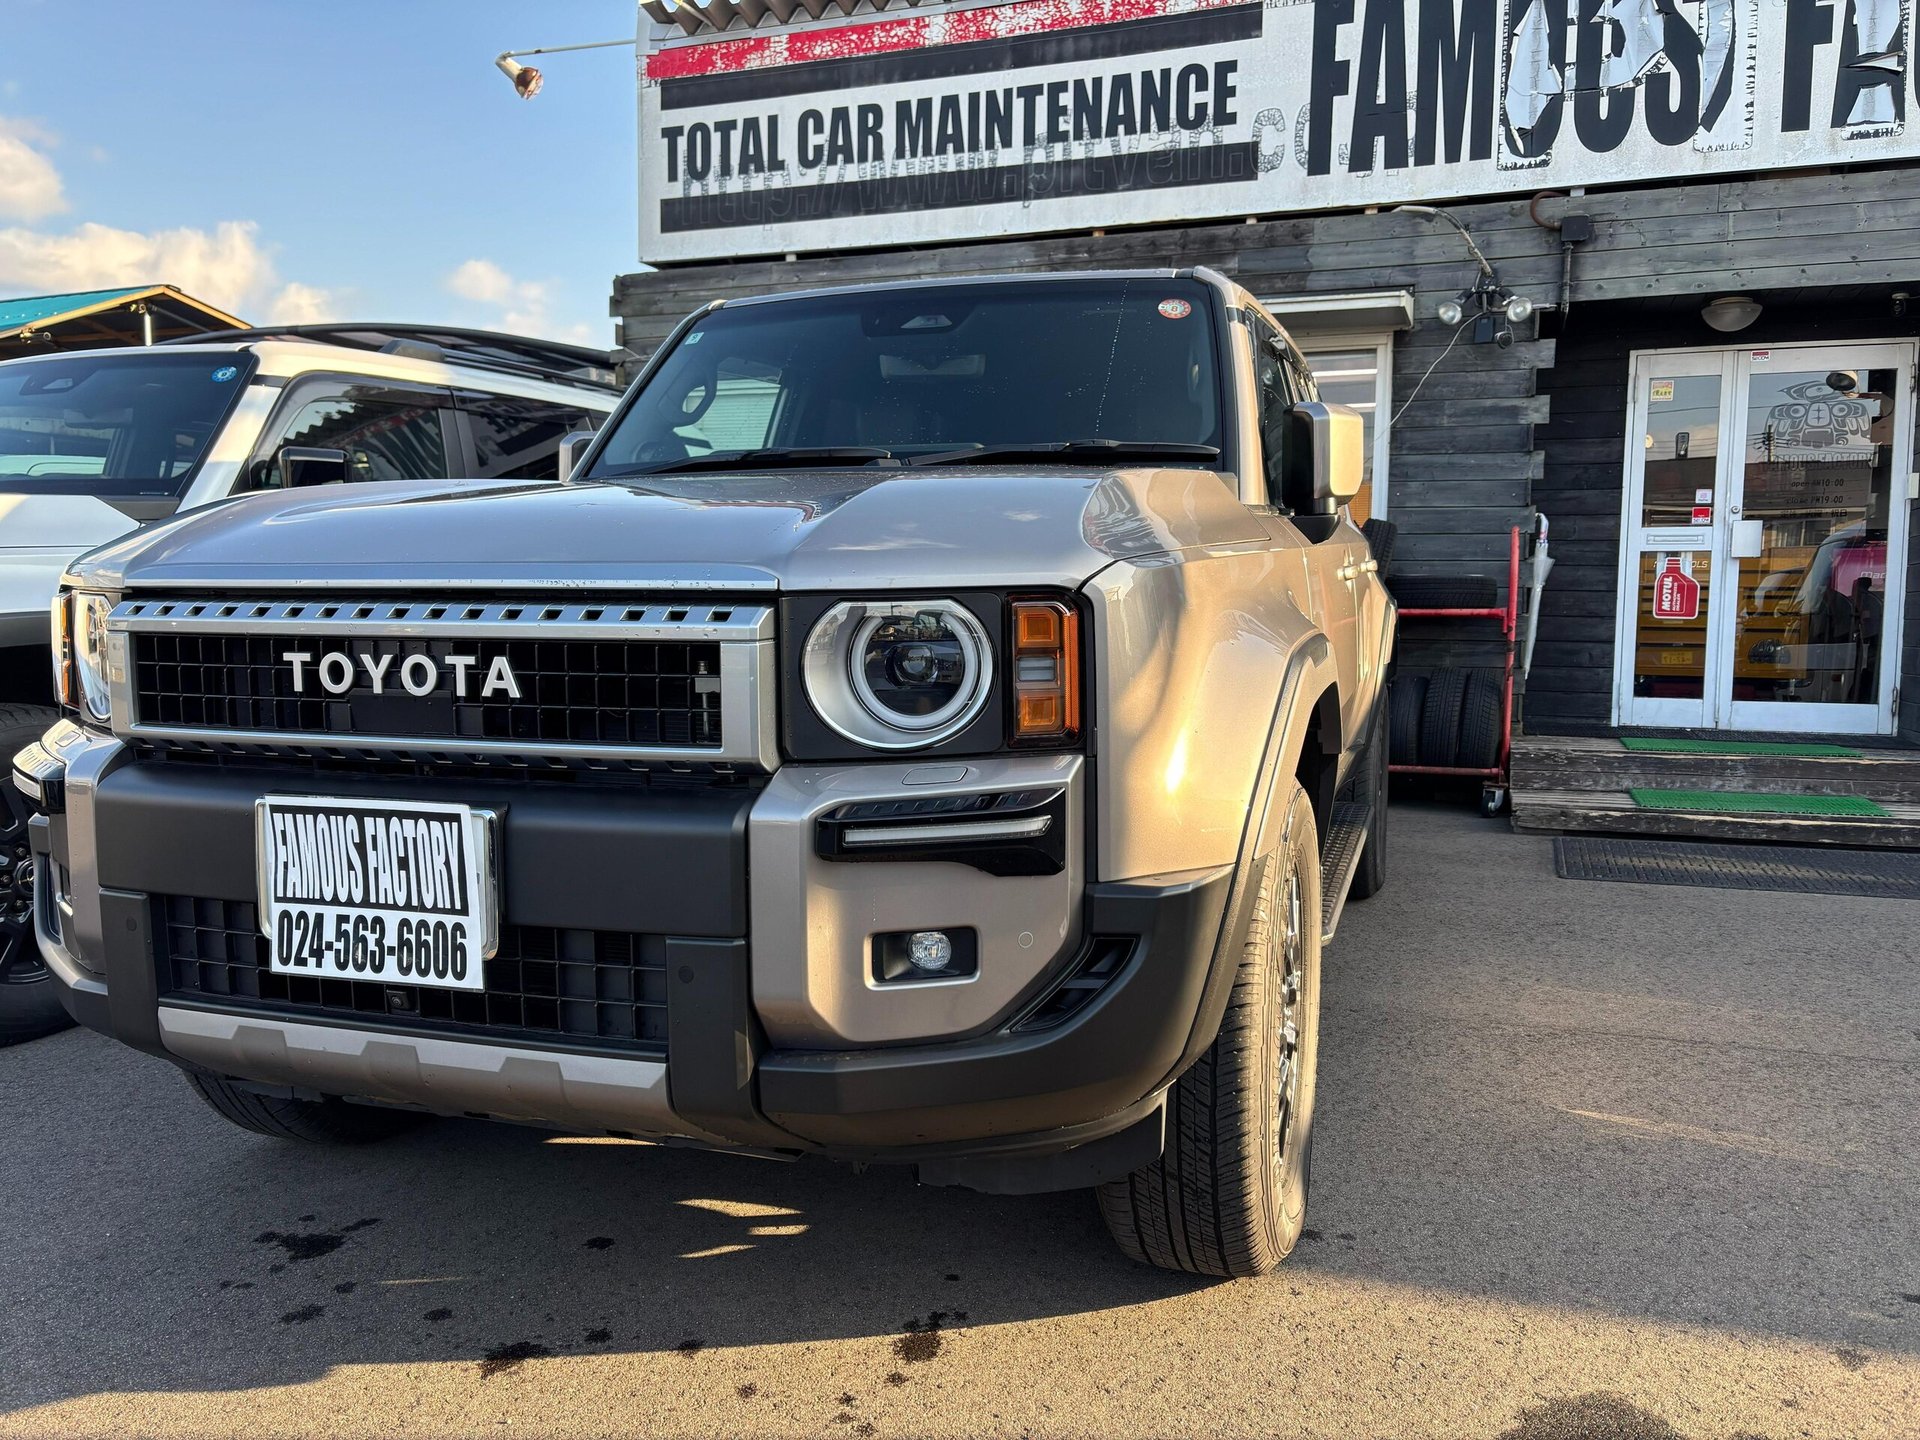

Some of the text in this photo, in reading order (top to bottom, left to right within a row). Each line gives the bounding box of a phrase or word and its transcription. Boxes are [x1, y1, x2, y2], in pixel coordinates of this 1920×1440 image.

[661, 60, 1238, 183] TOTAL CAR MAINTENANCE
[1661, 576, 1673, 611] MOTUL
[283, 651, 522, 699] TOYOTA
[272, 812, 463, 911] FAMOUS FACTORY
[276, 909, 468, 982] 024-563-6606
